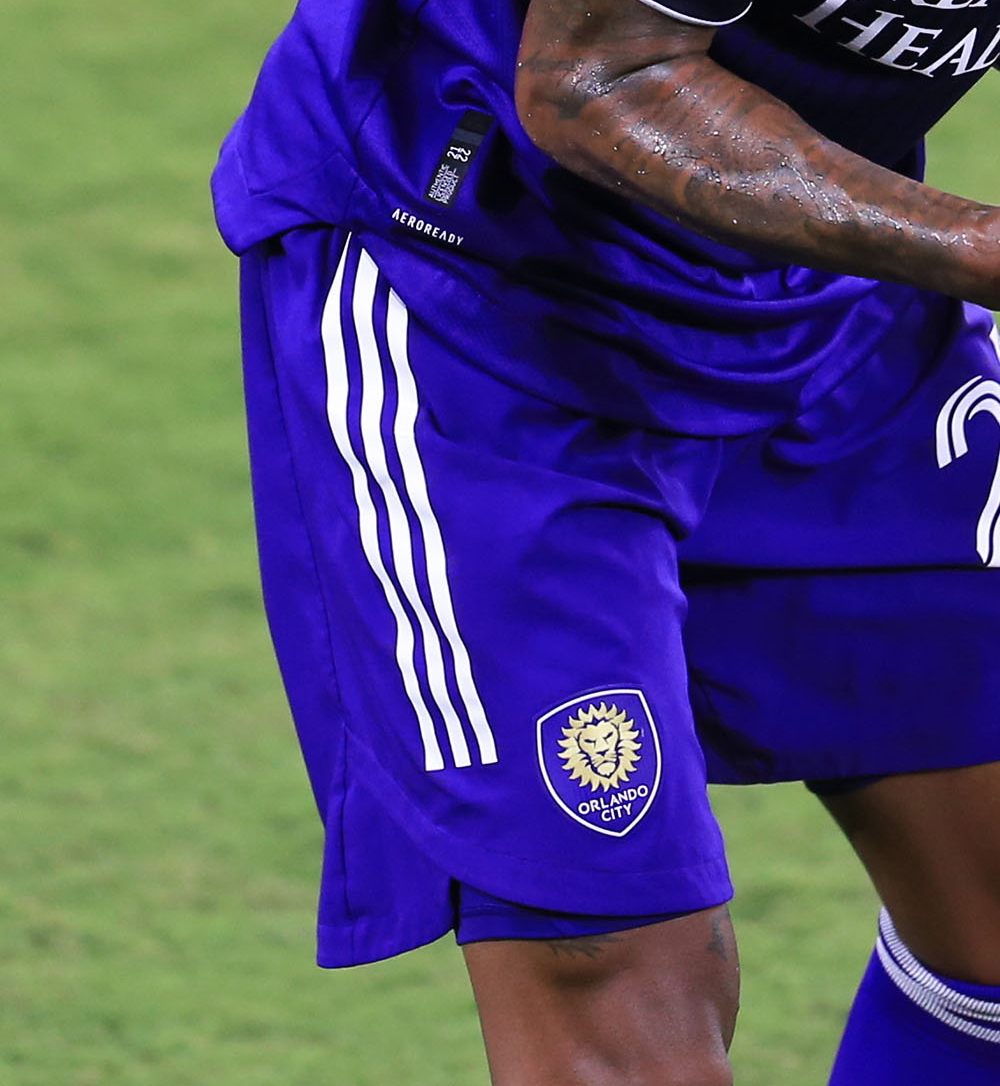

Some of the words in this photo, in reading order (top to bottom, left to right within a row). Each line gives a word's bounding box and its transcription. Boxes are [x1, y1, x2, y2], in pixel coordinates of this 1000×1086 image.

[391, 208, 464, 246] AEROREADY
[578, 785, 648, 815] ORLANDO
[601, 803, 632, 822] CITY
